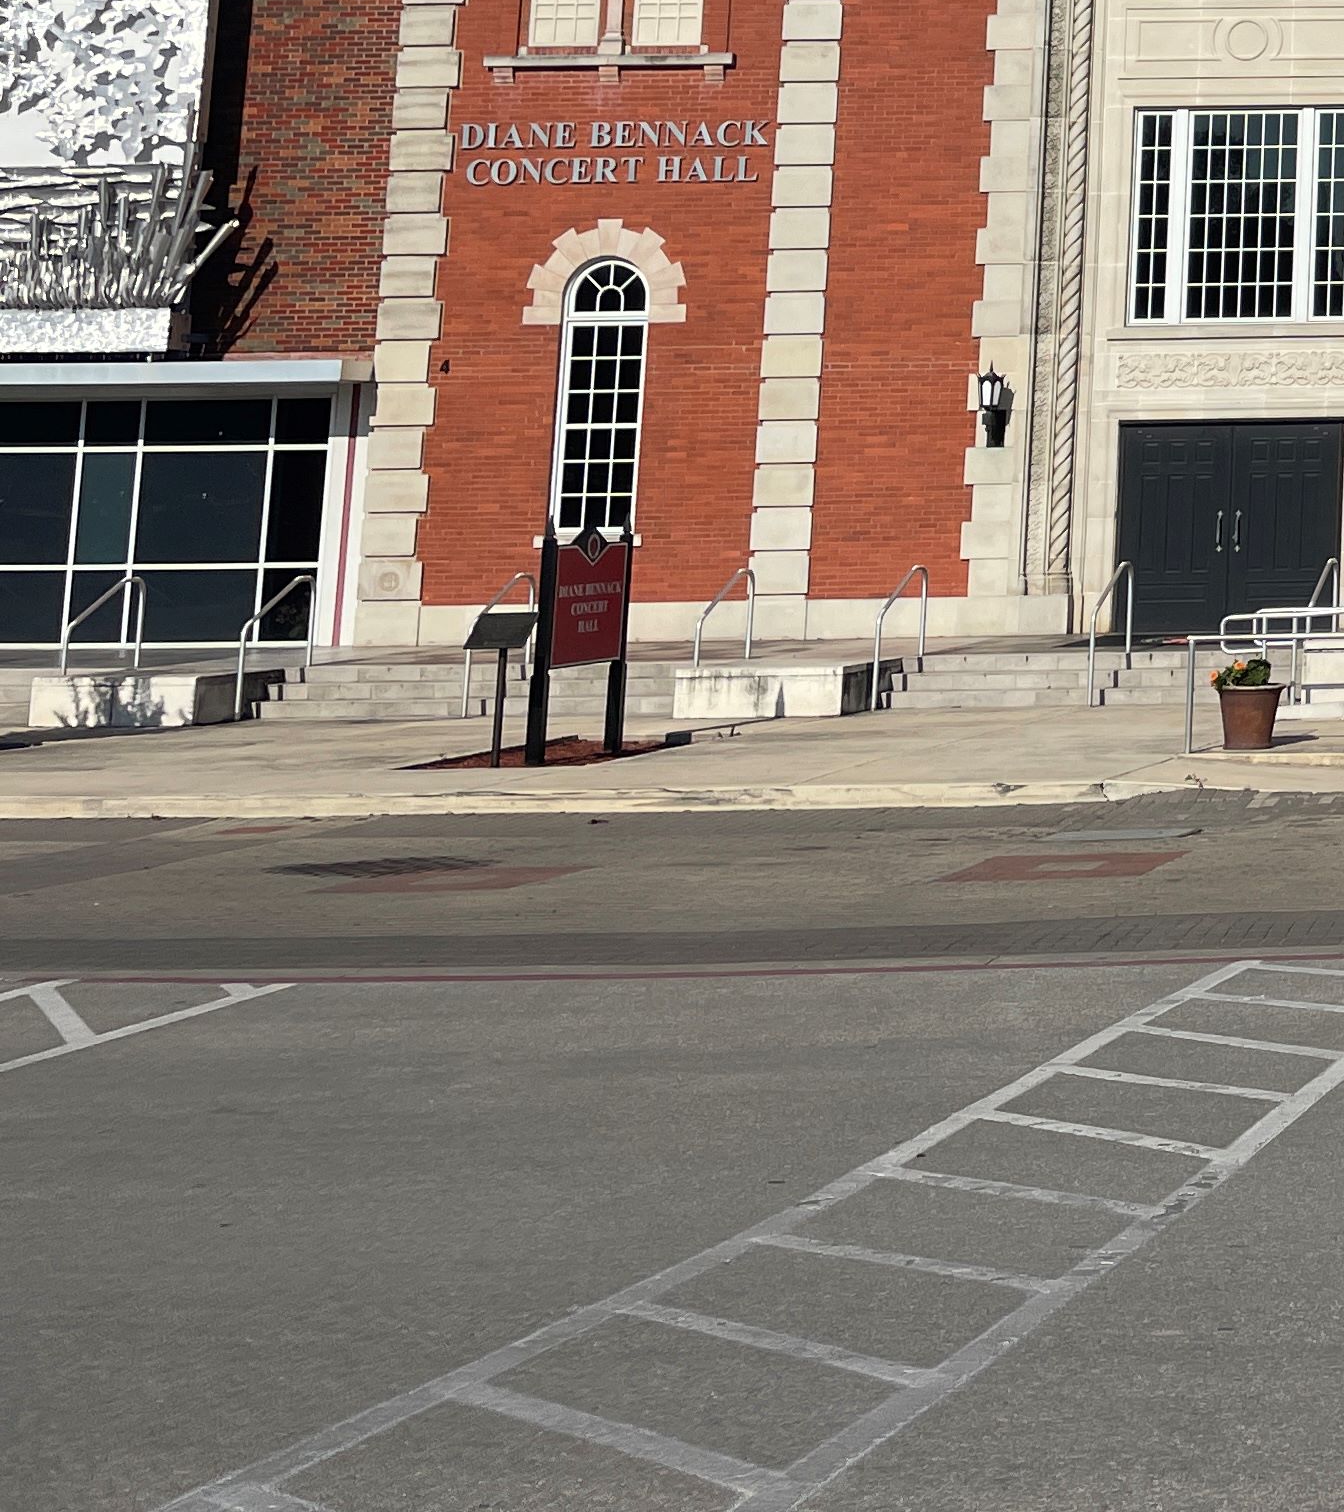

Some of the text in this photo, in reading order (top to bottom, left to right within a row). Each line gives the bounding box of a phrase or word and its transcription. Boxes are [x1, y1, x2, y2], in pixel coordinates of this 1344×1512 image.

[460, 119, 770, 150] DIANE BENNACK
[466, 155, 759, 186] CONCERT HALL
[558, 584, 584, 598] DIANE
[570, 600, 608, 616] CONCERT
[577, 619, 599, 632] HALL
